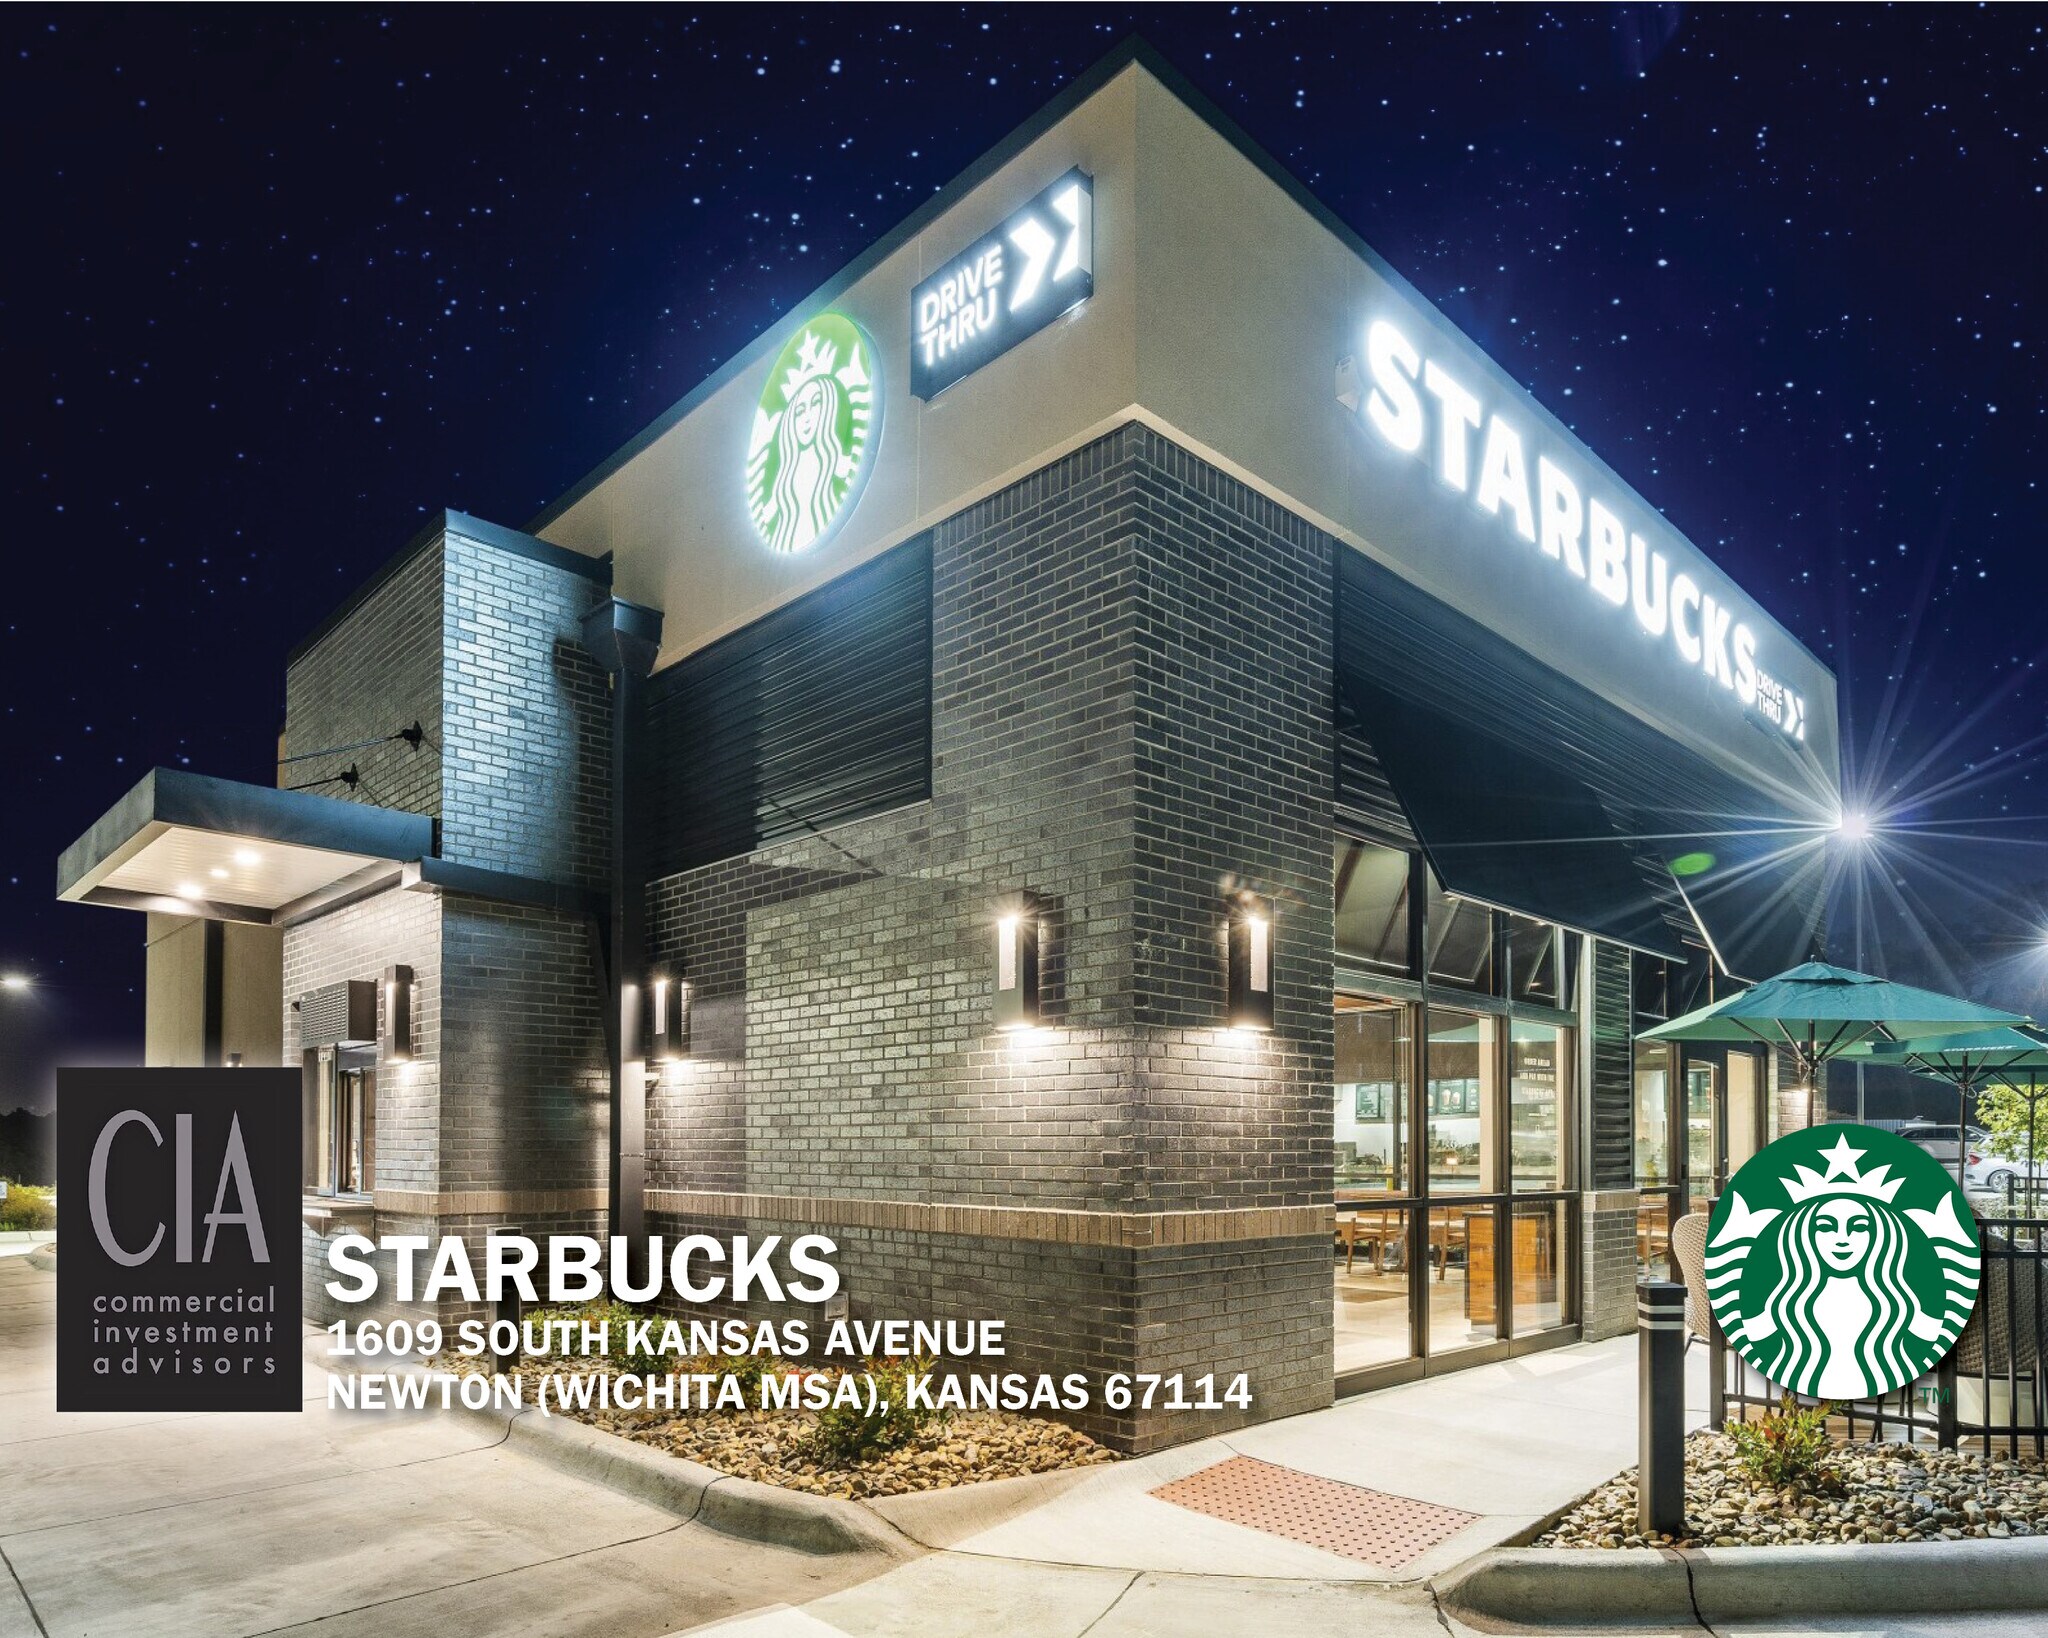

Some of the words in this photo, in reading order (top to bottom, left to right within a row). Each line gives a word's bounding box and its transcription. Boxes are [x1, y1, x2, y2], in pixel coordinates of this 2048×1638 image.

[920, 243, 1004, 334] DRIVE
[920, 286, 997, 367] THRU
[1366, 319, 1758, 703] STARBUCKS
[1756, 668, 1783, 706] DRIVE
[1757, 689, 1782, 725] THRU
